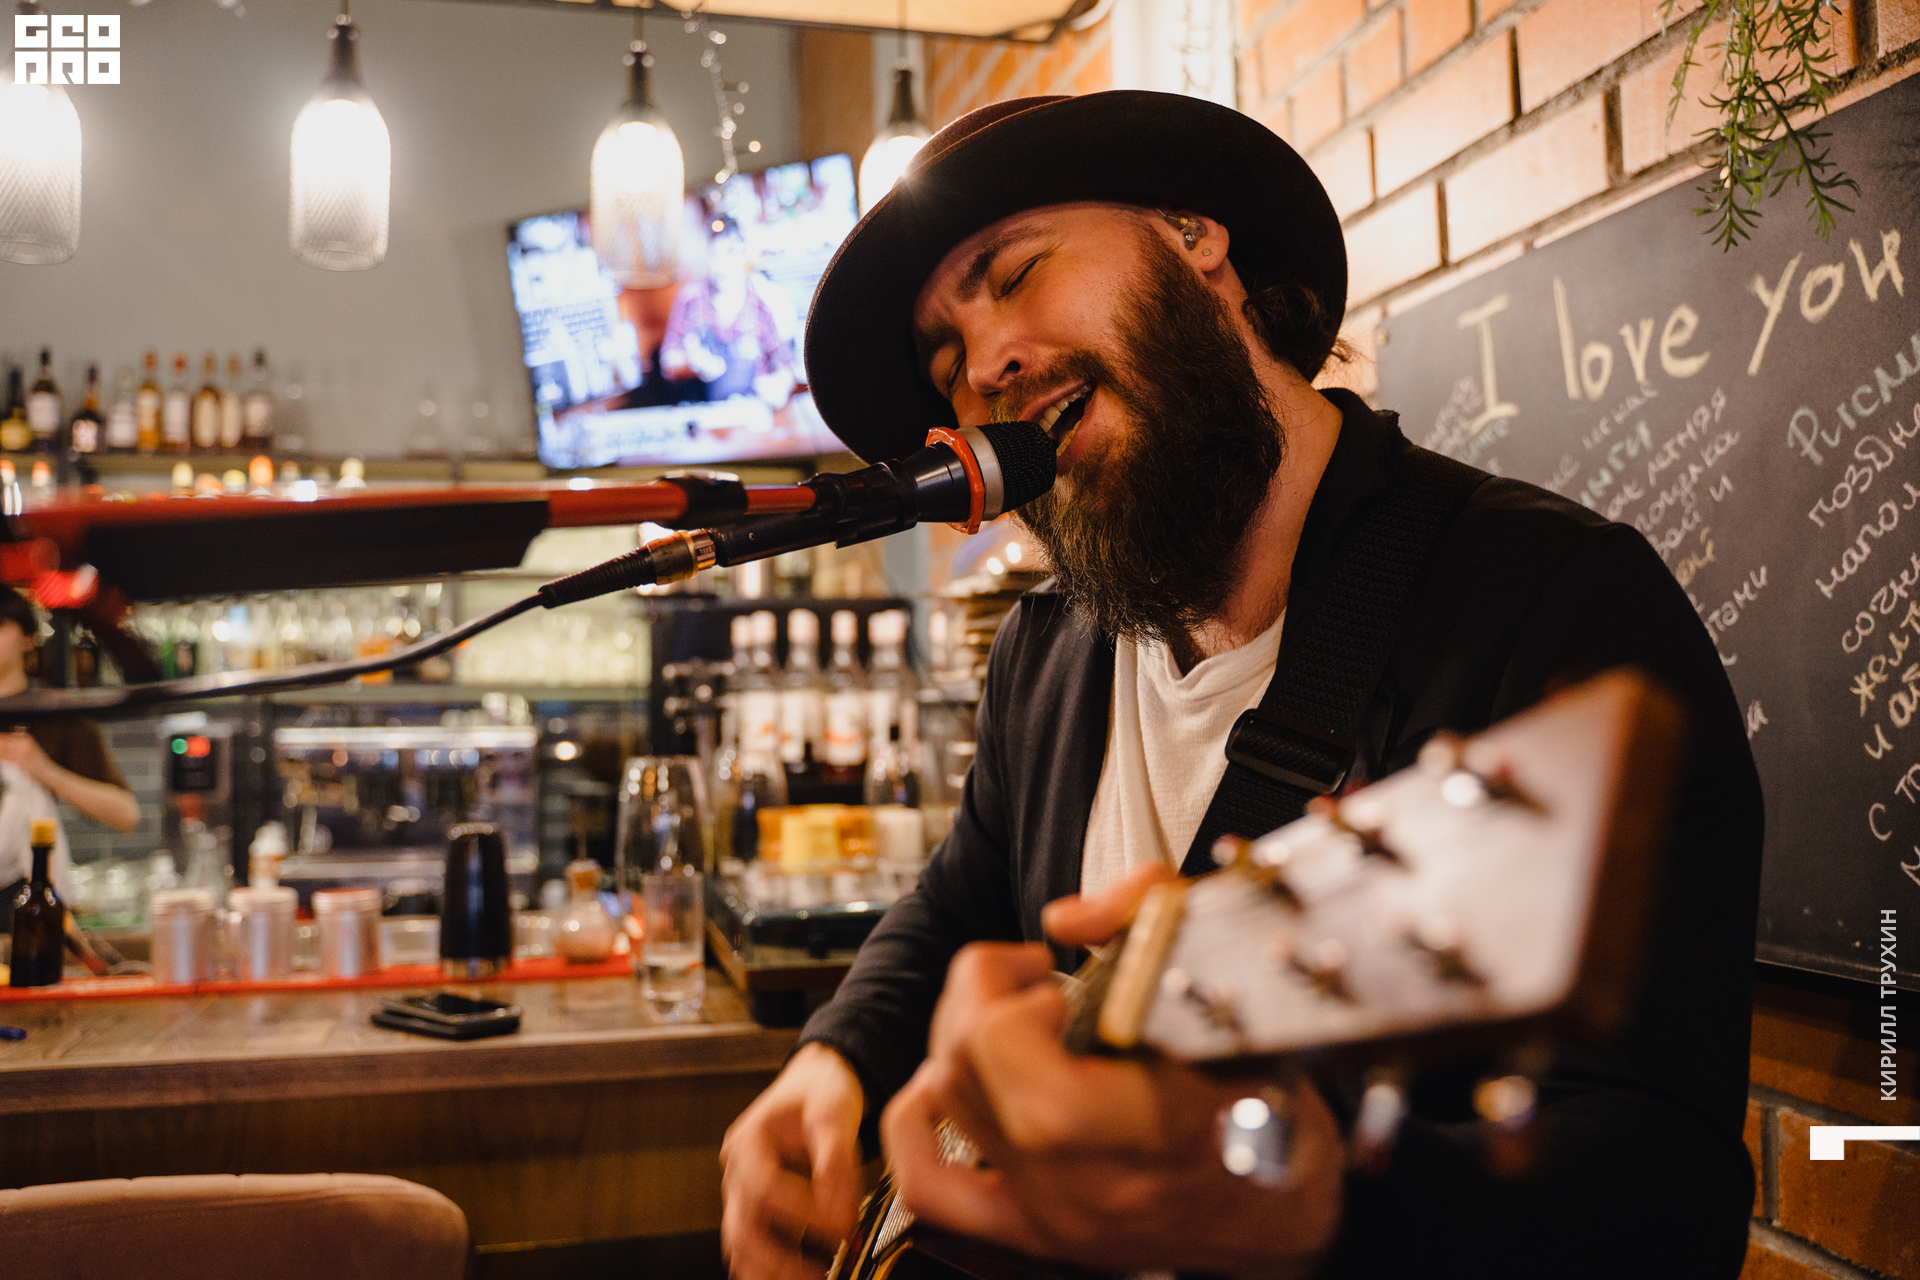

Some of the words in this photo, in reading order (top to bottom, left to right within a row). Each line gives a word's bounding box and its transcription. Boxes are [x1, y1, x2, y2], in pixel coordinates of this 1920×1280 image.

[1457, 293, 1519, 438] I
[1553, 276, 1710, 400] love
[1747, 229, 1904, 376] you
